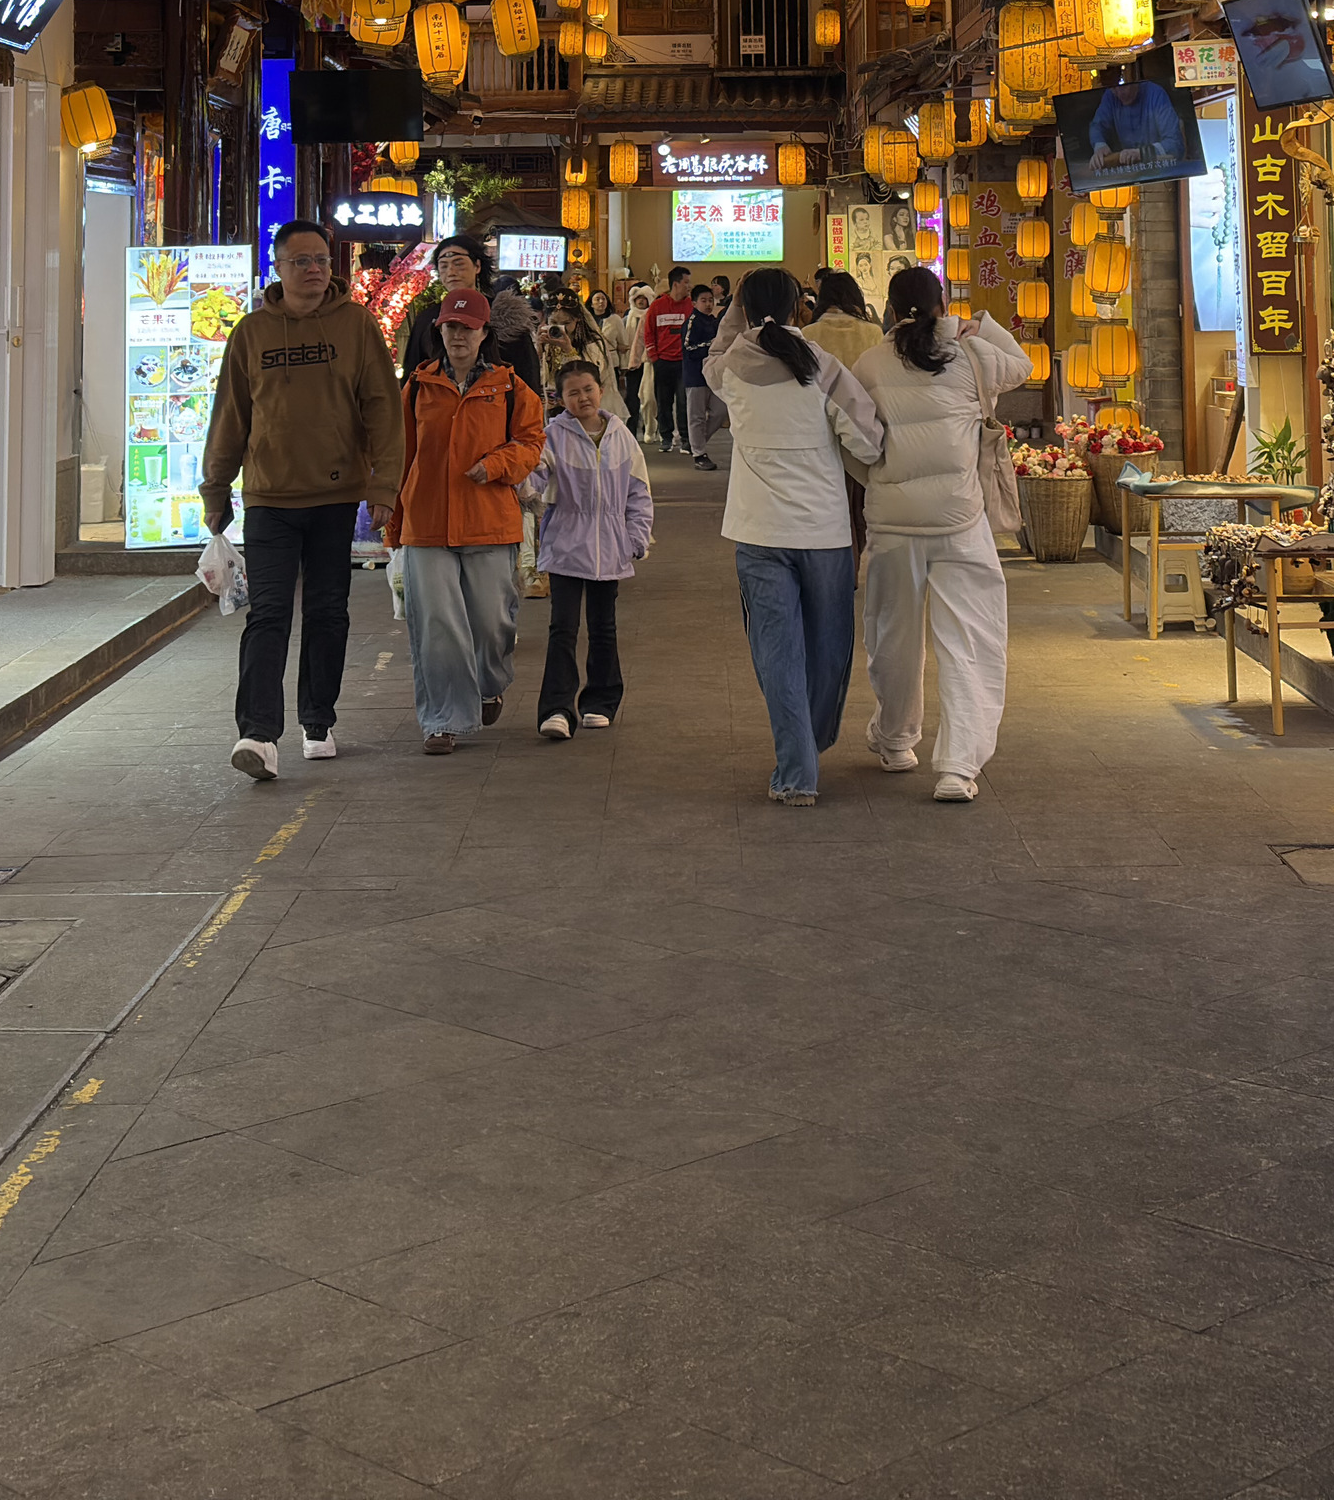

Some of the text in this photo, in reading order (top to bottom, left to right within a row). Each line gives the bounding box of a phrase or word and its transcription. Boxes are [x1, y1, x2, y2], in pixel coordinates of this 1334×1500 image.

[1177, 46, 1237, 64] 棉花糖
[259, 106, 284, 199] 唐卡
[676, 204, 779, 222] 纯天然 更健康
[832, 218, 843, 253] 现做现卖
[973, 188, 1005, 289] 鸡血藤
[1252, 115, 1294, 336] 山古木留百年
